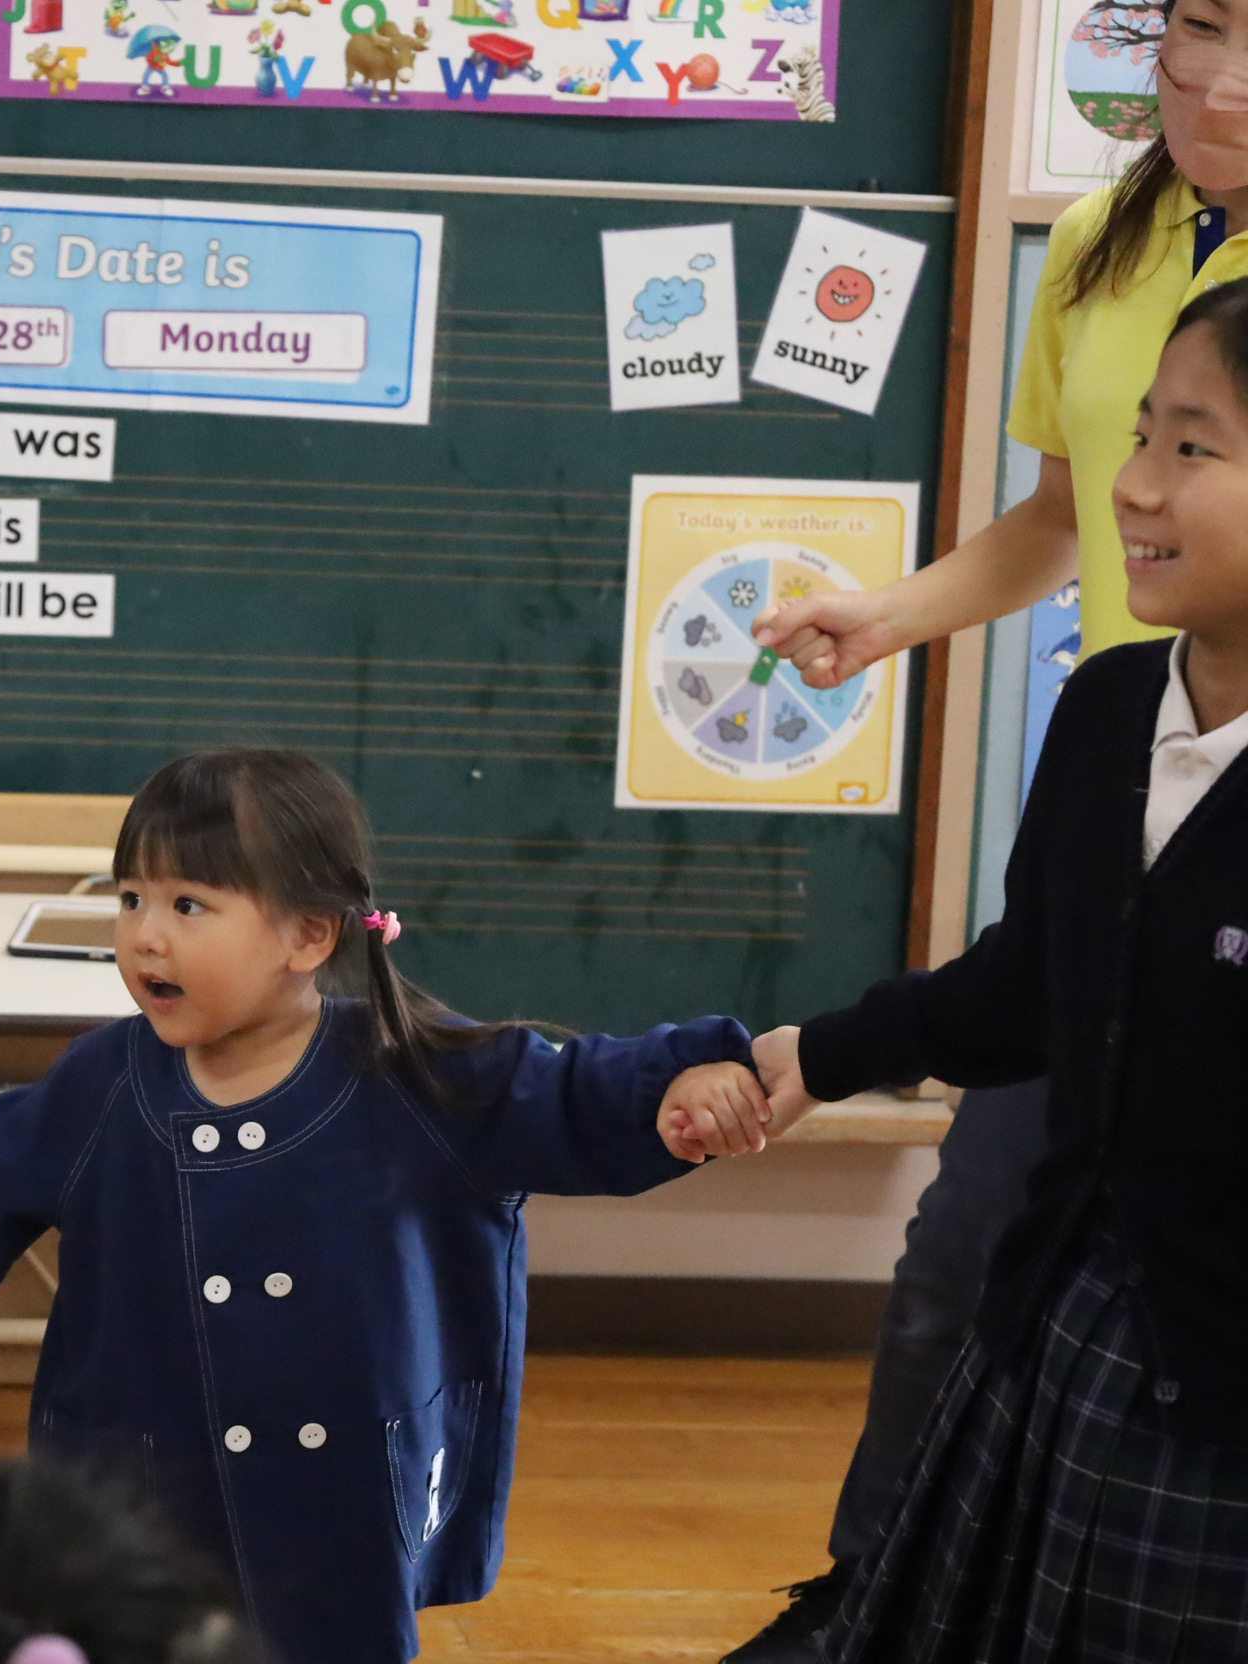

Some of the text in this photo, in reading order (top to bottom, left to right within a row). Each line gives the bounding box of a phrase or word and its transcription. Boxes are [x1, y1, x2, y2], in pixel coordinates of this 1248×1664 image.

[693, 0, 727, 38] R
[57, 38, 785, 106] T U V W X Y Z
[56, 233, 185, 285] Date
[204, 237, 251, 289] is
[160, 321, 311, 364] Monday
[622, 351, 725, 380] cloudy
[774, 339, 870, 386] sunny
[12, 427, 102, 458] was
[677, 511, 752, 532] Today's
[759, 512, 841, 530] weather
[39, 582, 98, 619] be
